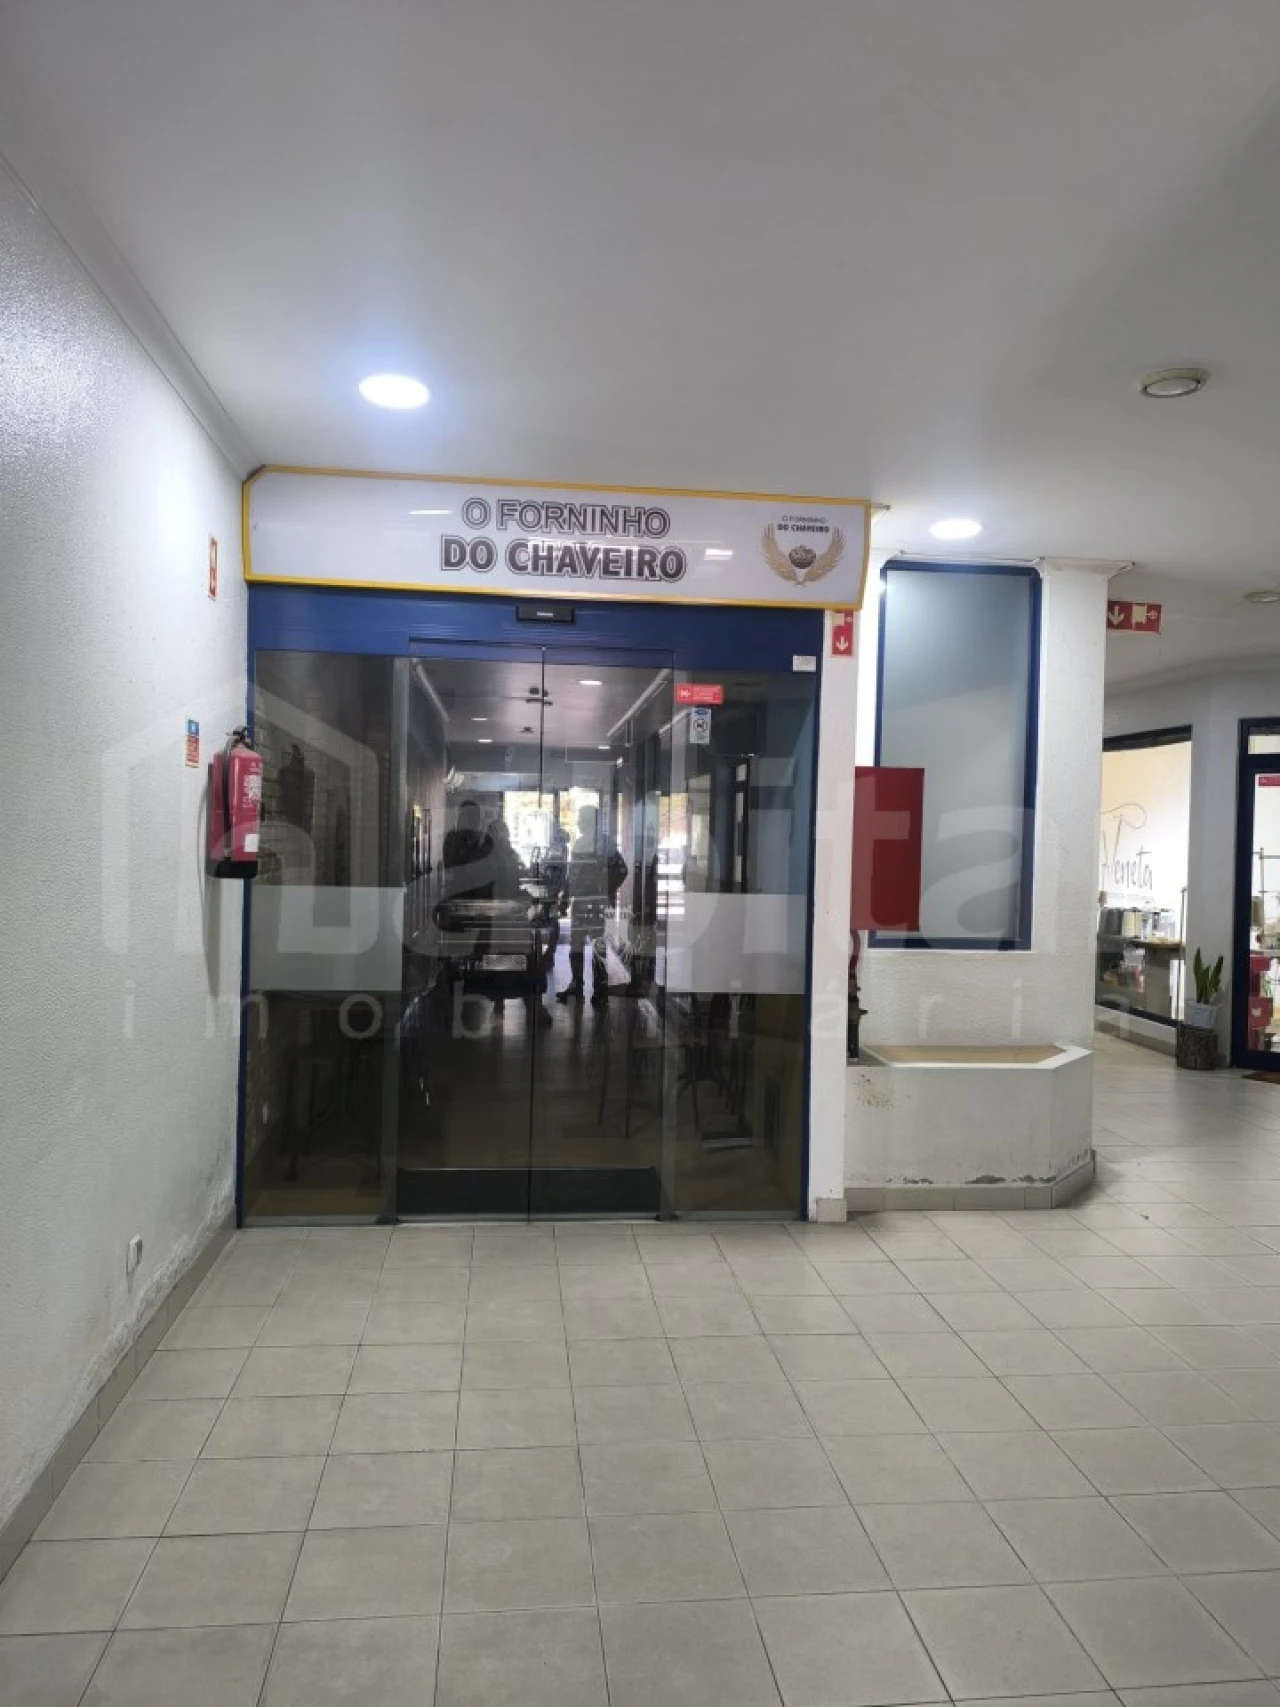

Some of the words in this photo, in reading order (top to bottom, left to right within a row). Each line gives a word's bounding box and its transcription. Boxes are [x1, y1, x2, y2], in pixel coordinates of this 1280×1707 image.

[462, 497, 491, 530] O
[496, 498, 670, 540] FORNINHO
[441, 534, 497, 574] DO
[505, 537, 687, 584] CHAVEIRO
